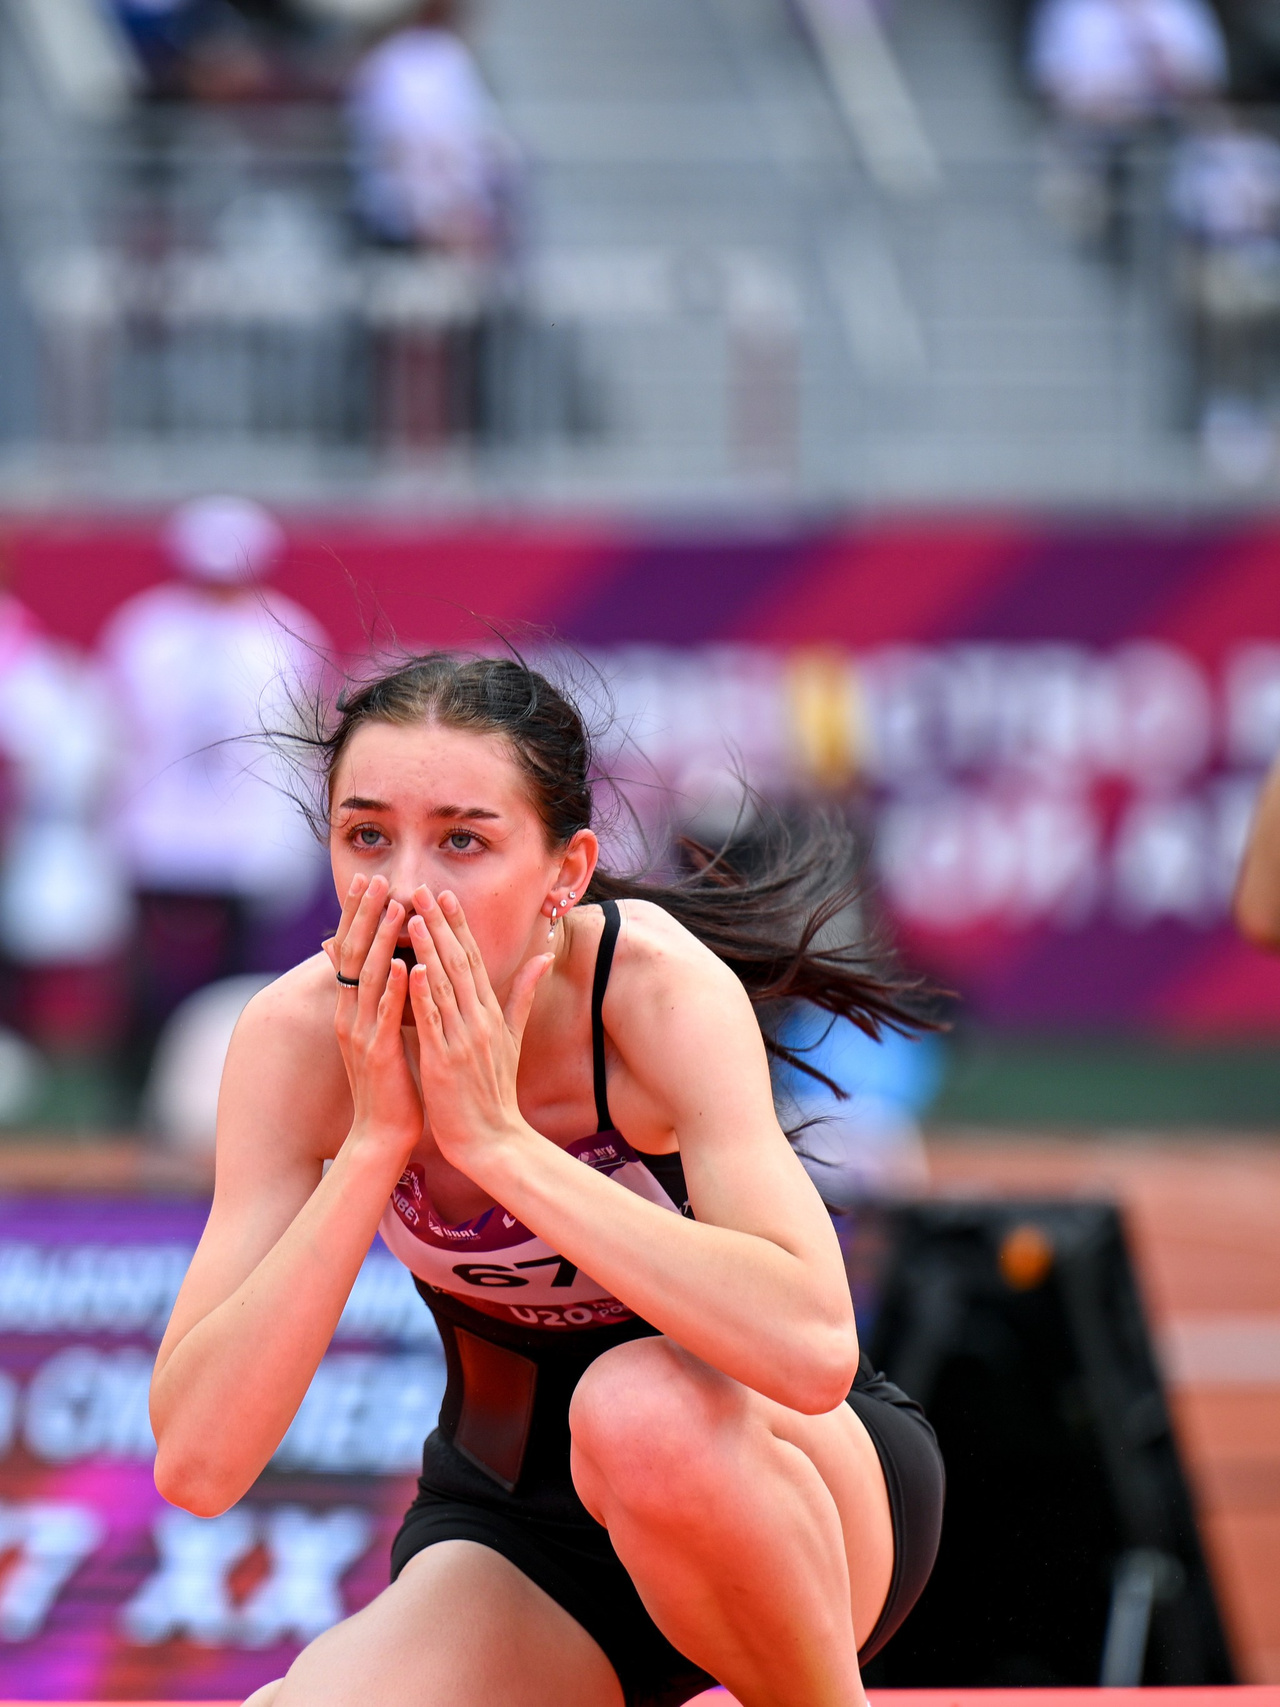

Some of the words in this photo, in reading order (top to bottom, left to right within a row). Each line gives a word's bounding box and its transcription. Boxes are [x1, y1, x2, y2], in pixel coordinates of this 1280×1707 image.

[452, 1254, 578, 1288] 67
[508, 1305, 593, 1326] U20
[122, 1508, 378, 1648] XX
